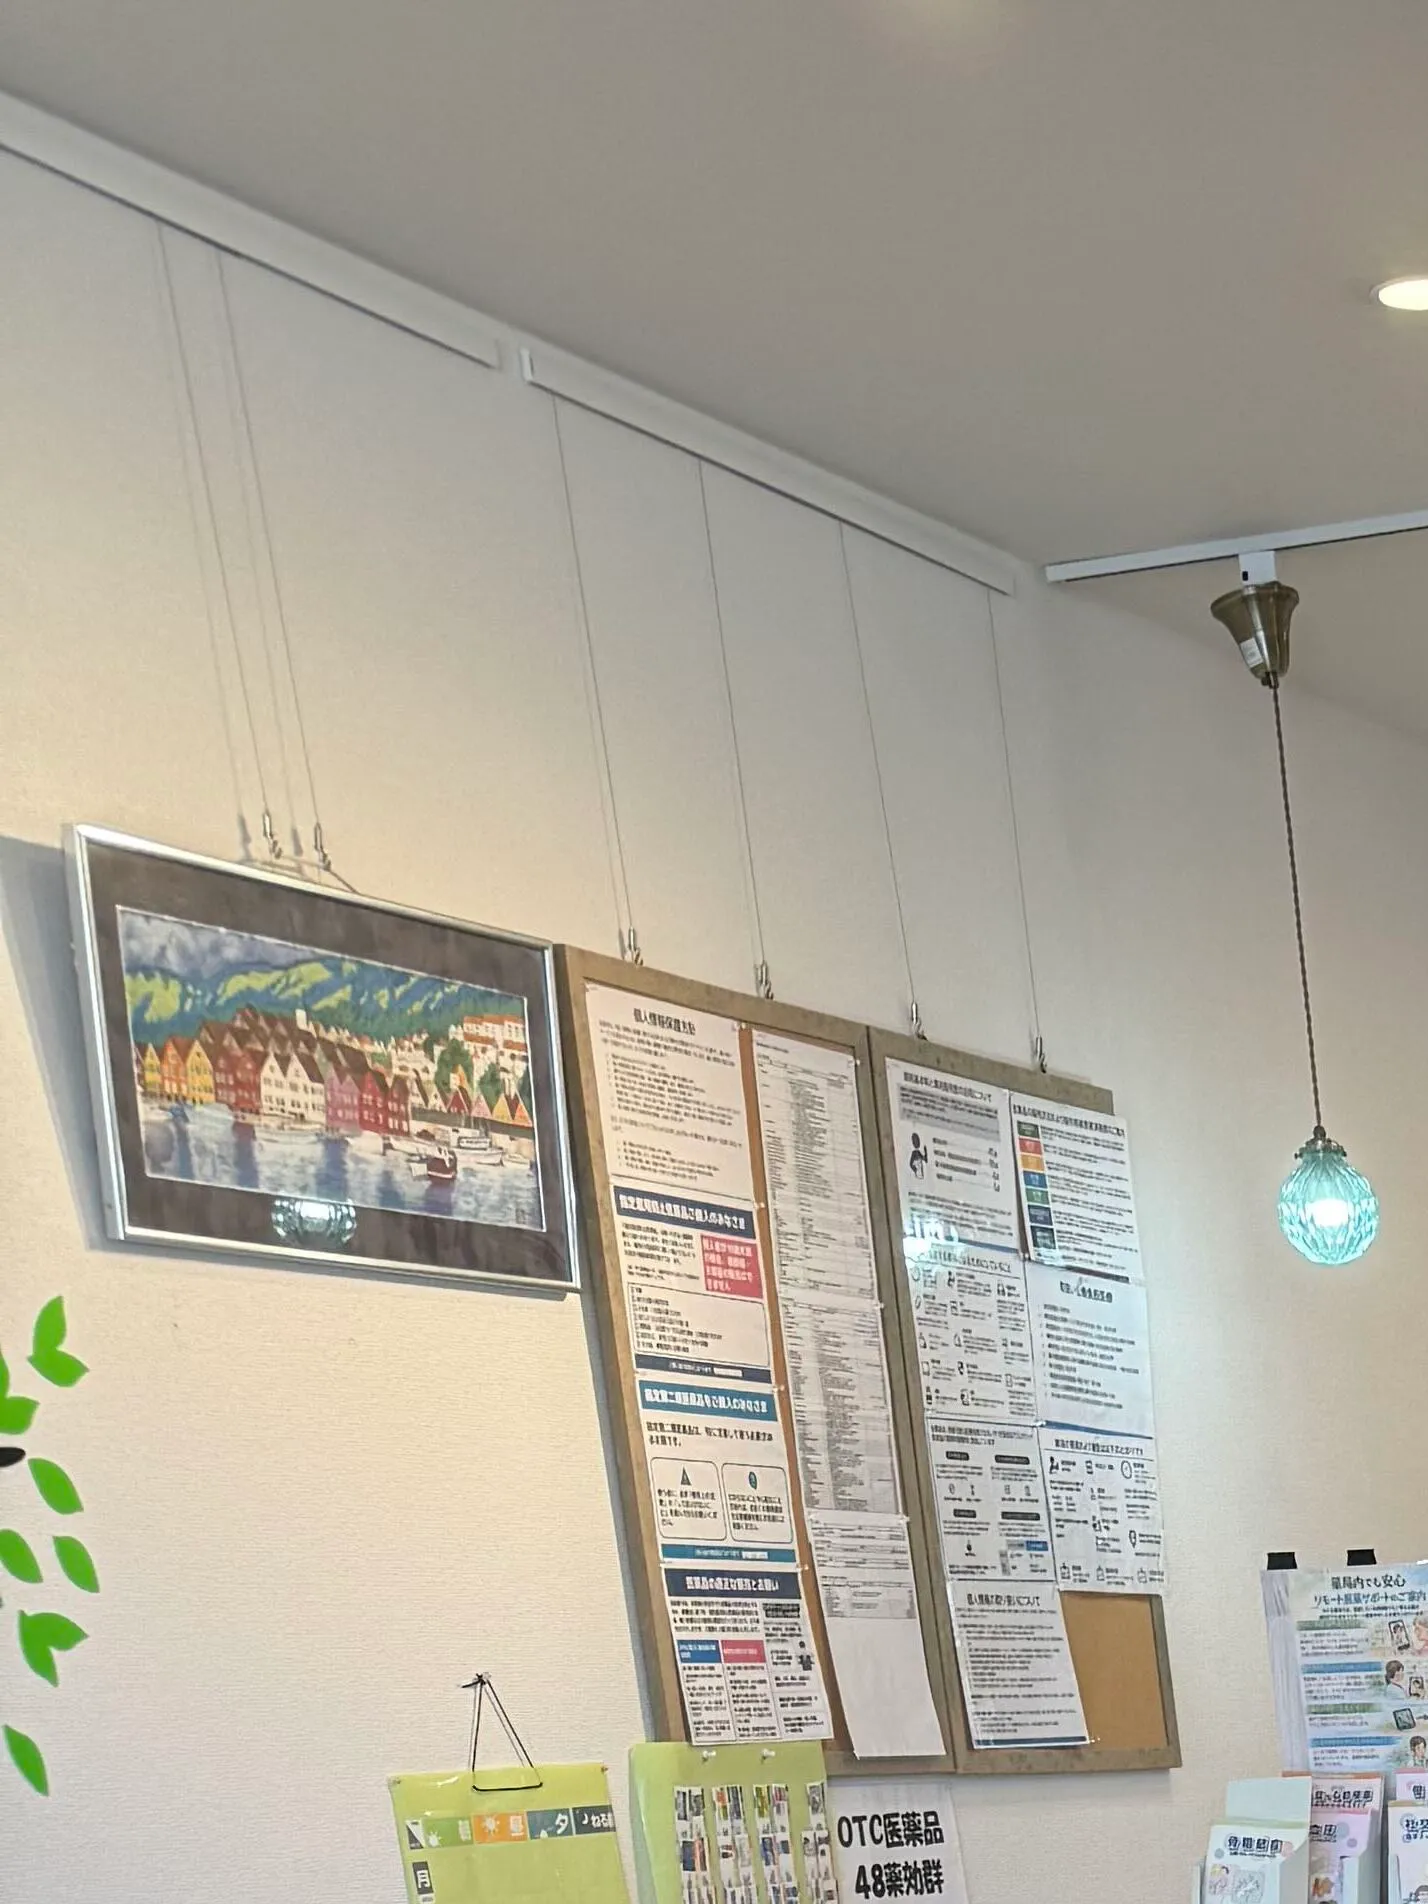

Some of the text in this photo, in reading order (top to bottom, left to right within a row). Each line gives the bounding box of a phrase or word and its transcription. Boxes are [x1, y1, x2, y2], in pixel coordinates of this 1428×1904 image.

[555, 1812, 569, 1835] 夕
[837, 1810, 945, 1849] OTC医薬品
[416, 1869, 431, 1889] 月
[855, 1858, 944, 1900] 48薬効群
